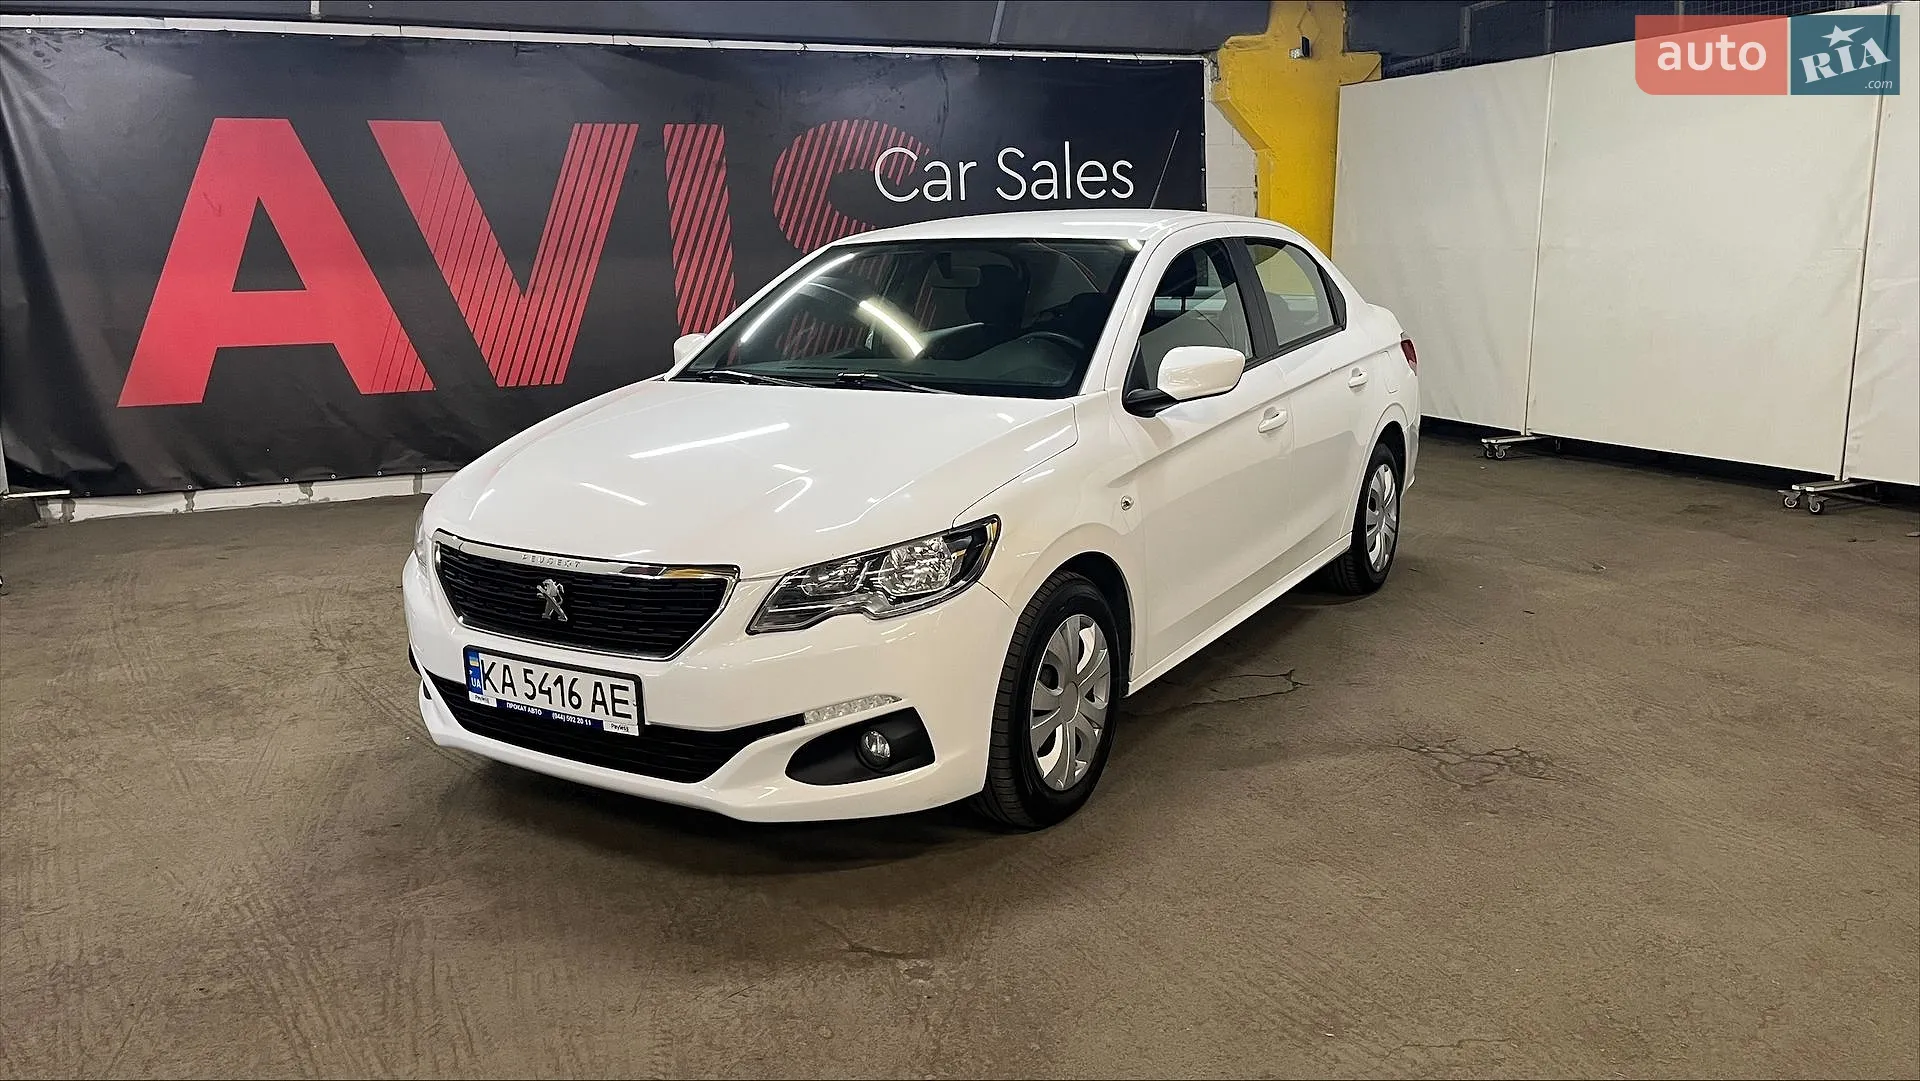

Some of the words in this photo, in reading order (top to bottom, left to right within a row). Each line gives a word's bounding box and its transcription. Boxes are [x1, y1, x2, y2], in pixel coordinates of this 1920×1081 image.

[874, 146, 977, 202] Car
[996, 140, 1135, 201] Sales
[118, 117, 935, 407] AVIS
[521, 554, 581, 568] PEUGEOT
[470, 677, 482, 690] UA
[480, 659, 517, 697] KA
[522, 667, 582, 710] 5416
[591, 681, 632, 719] AE
